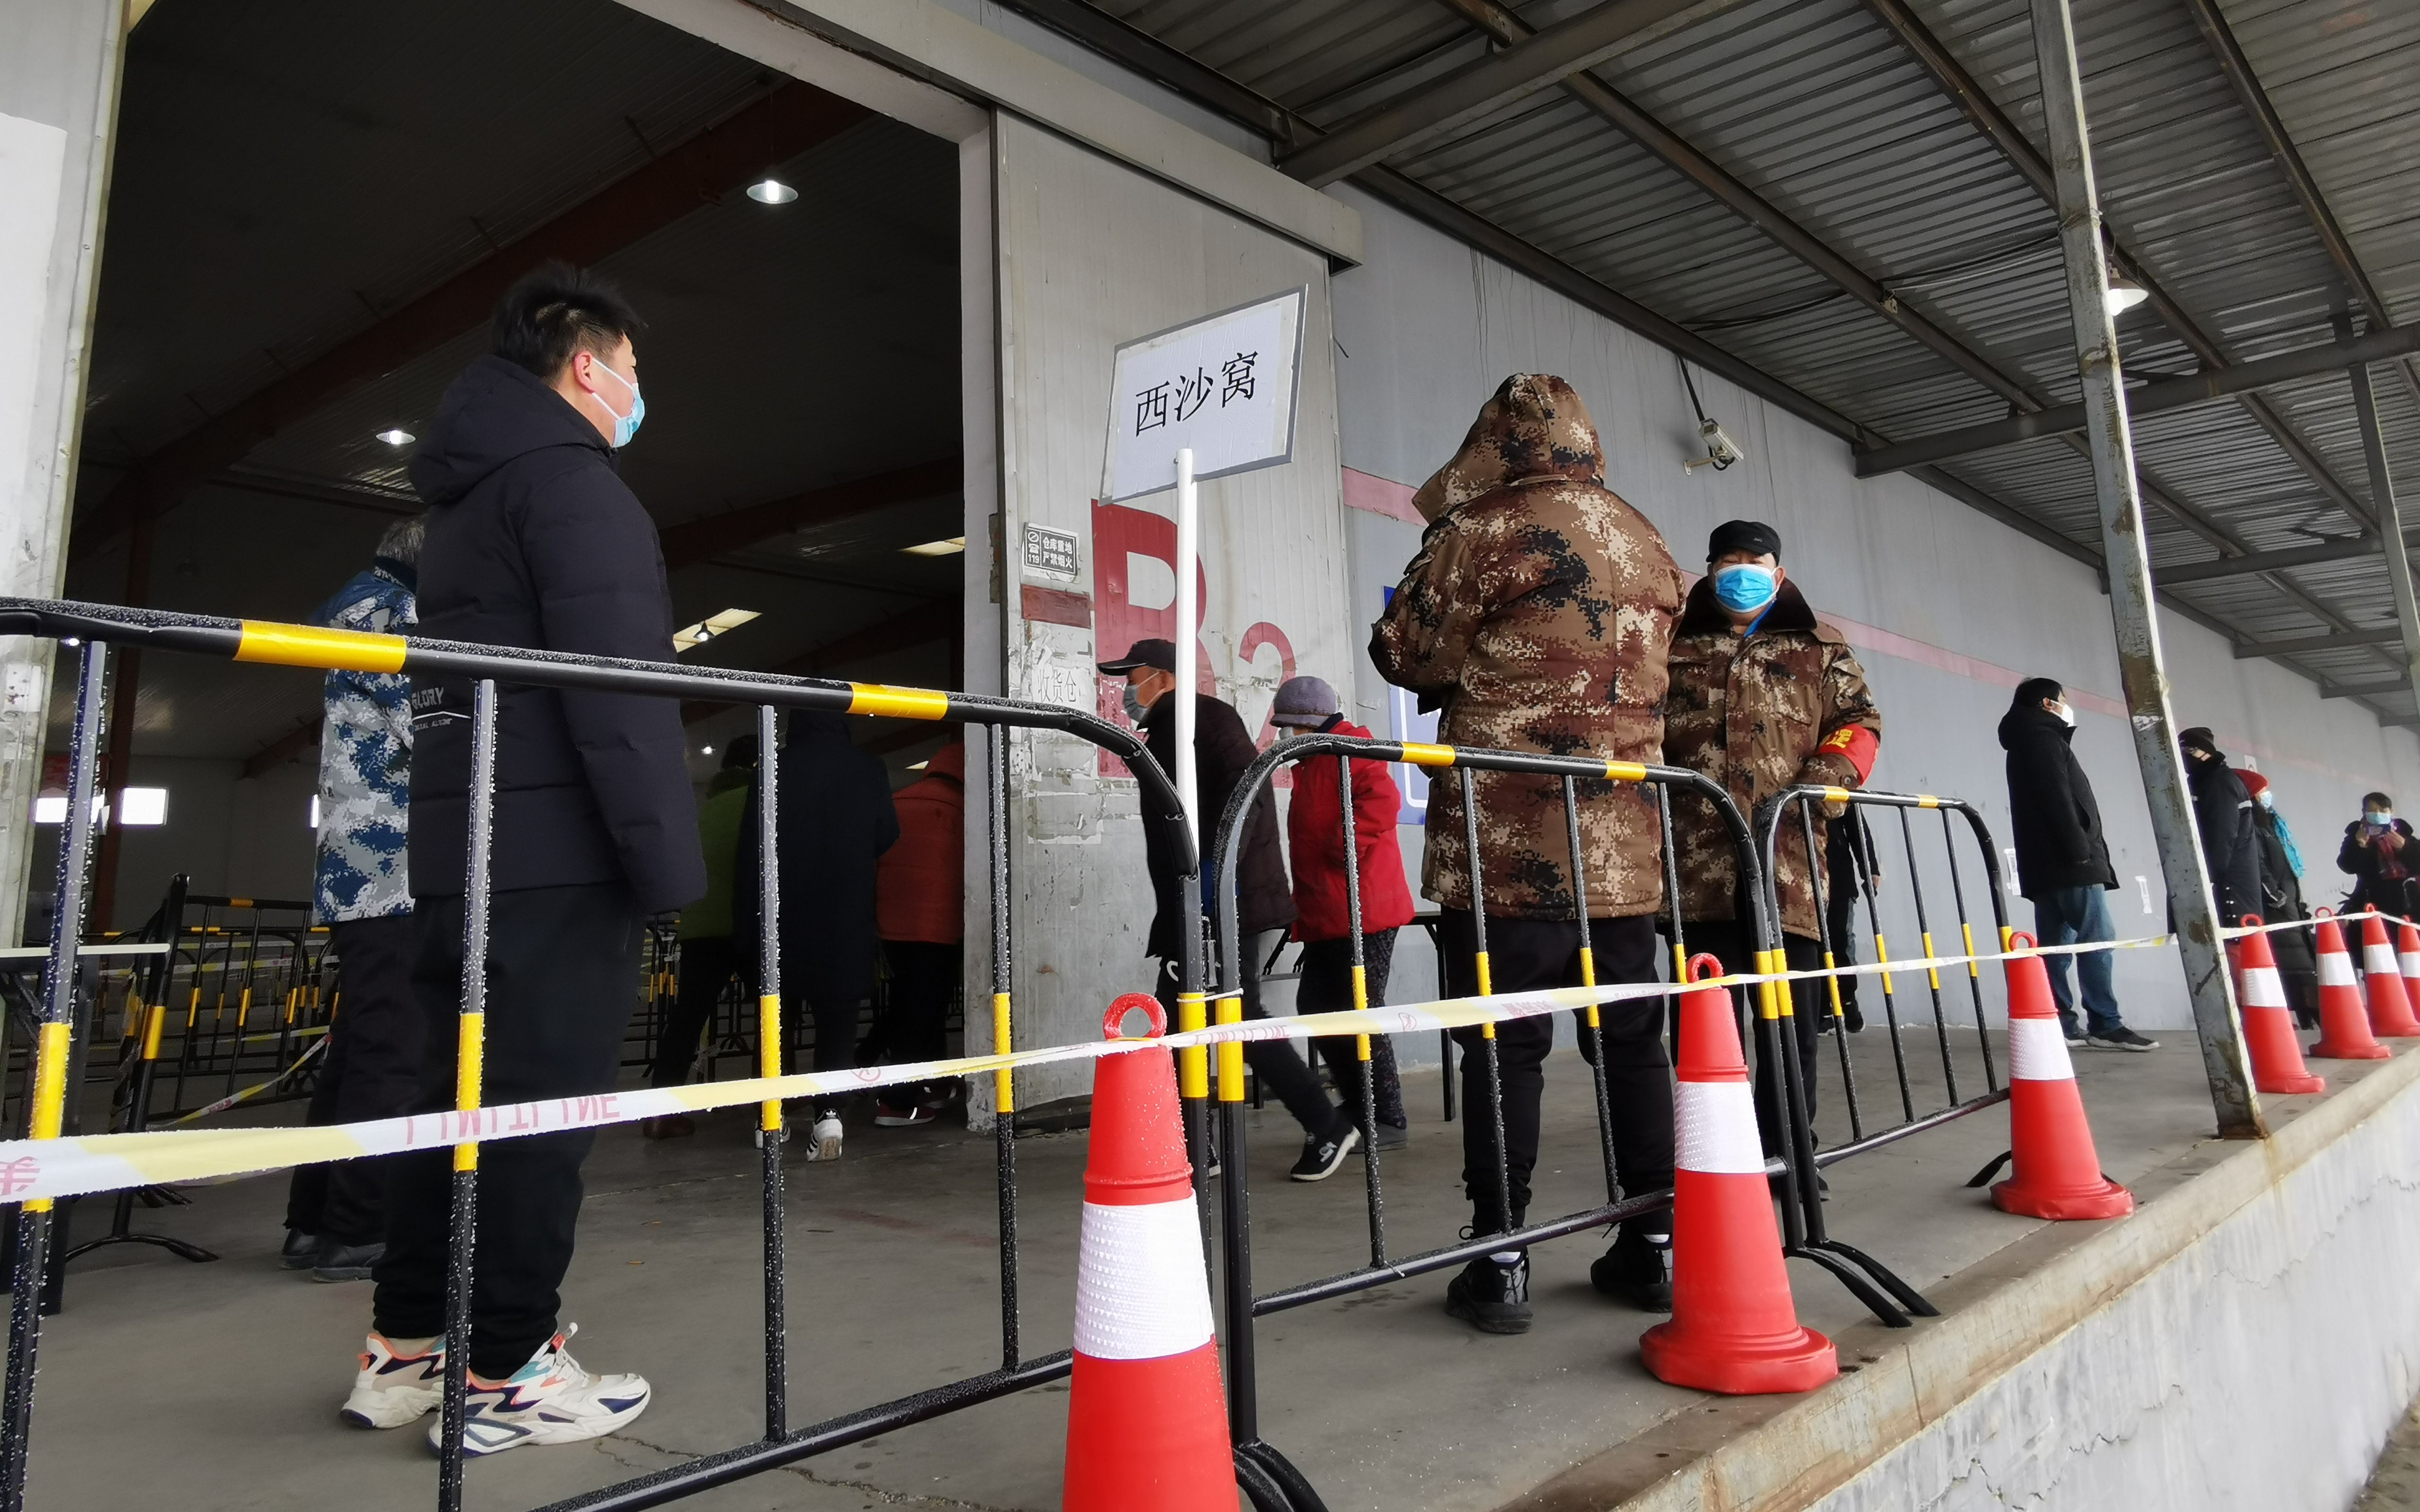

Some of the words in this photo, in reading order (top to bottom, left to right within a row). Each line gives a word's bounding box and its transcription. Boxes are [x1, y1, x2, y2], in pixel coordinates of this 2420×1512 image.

[1136, 351, 1258, 437] 西沙窝
[1042, 536, 1072, 554] 仓库重地
[1028, 554, 1039, 563] 119
[1042, 551, 1073, 569] 严禁烟火
[412, 687, 444, 710] GLORY
